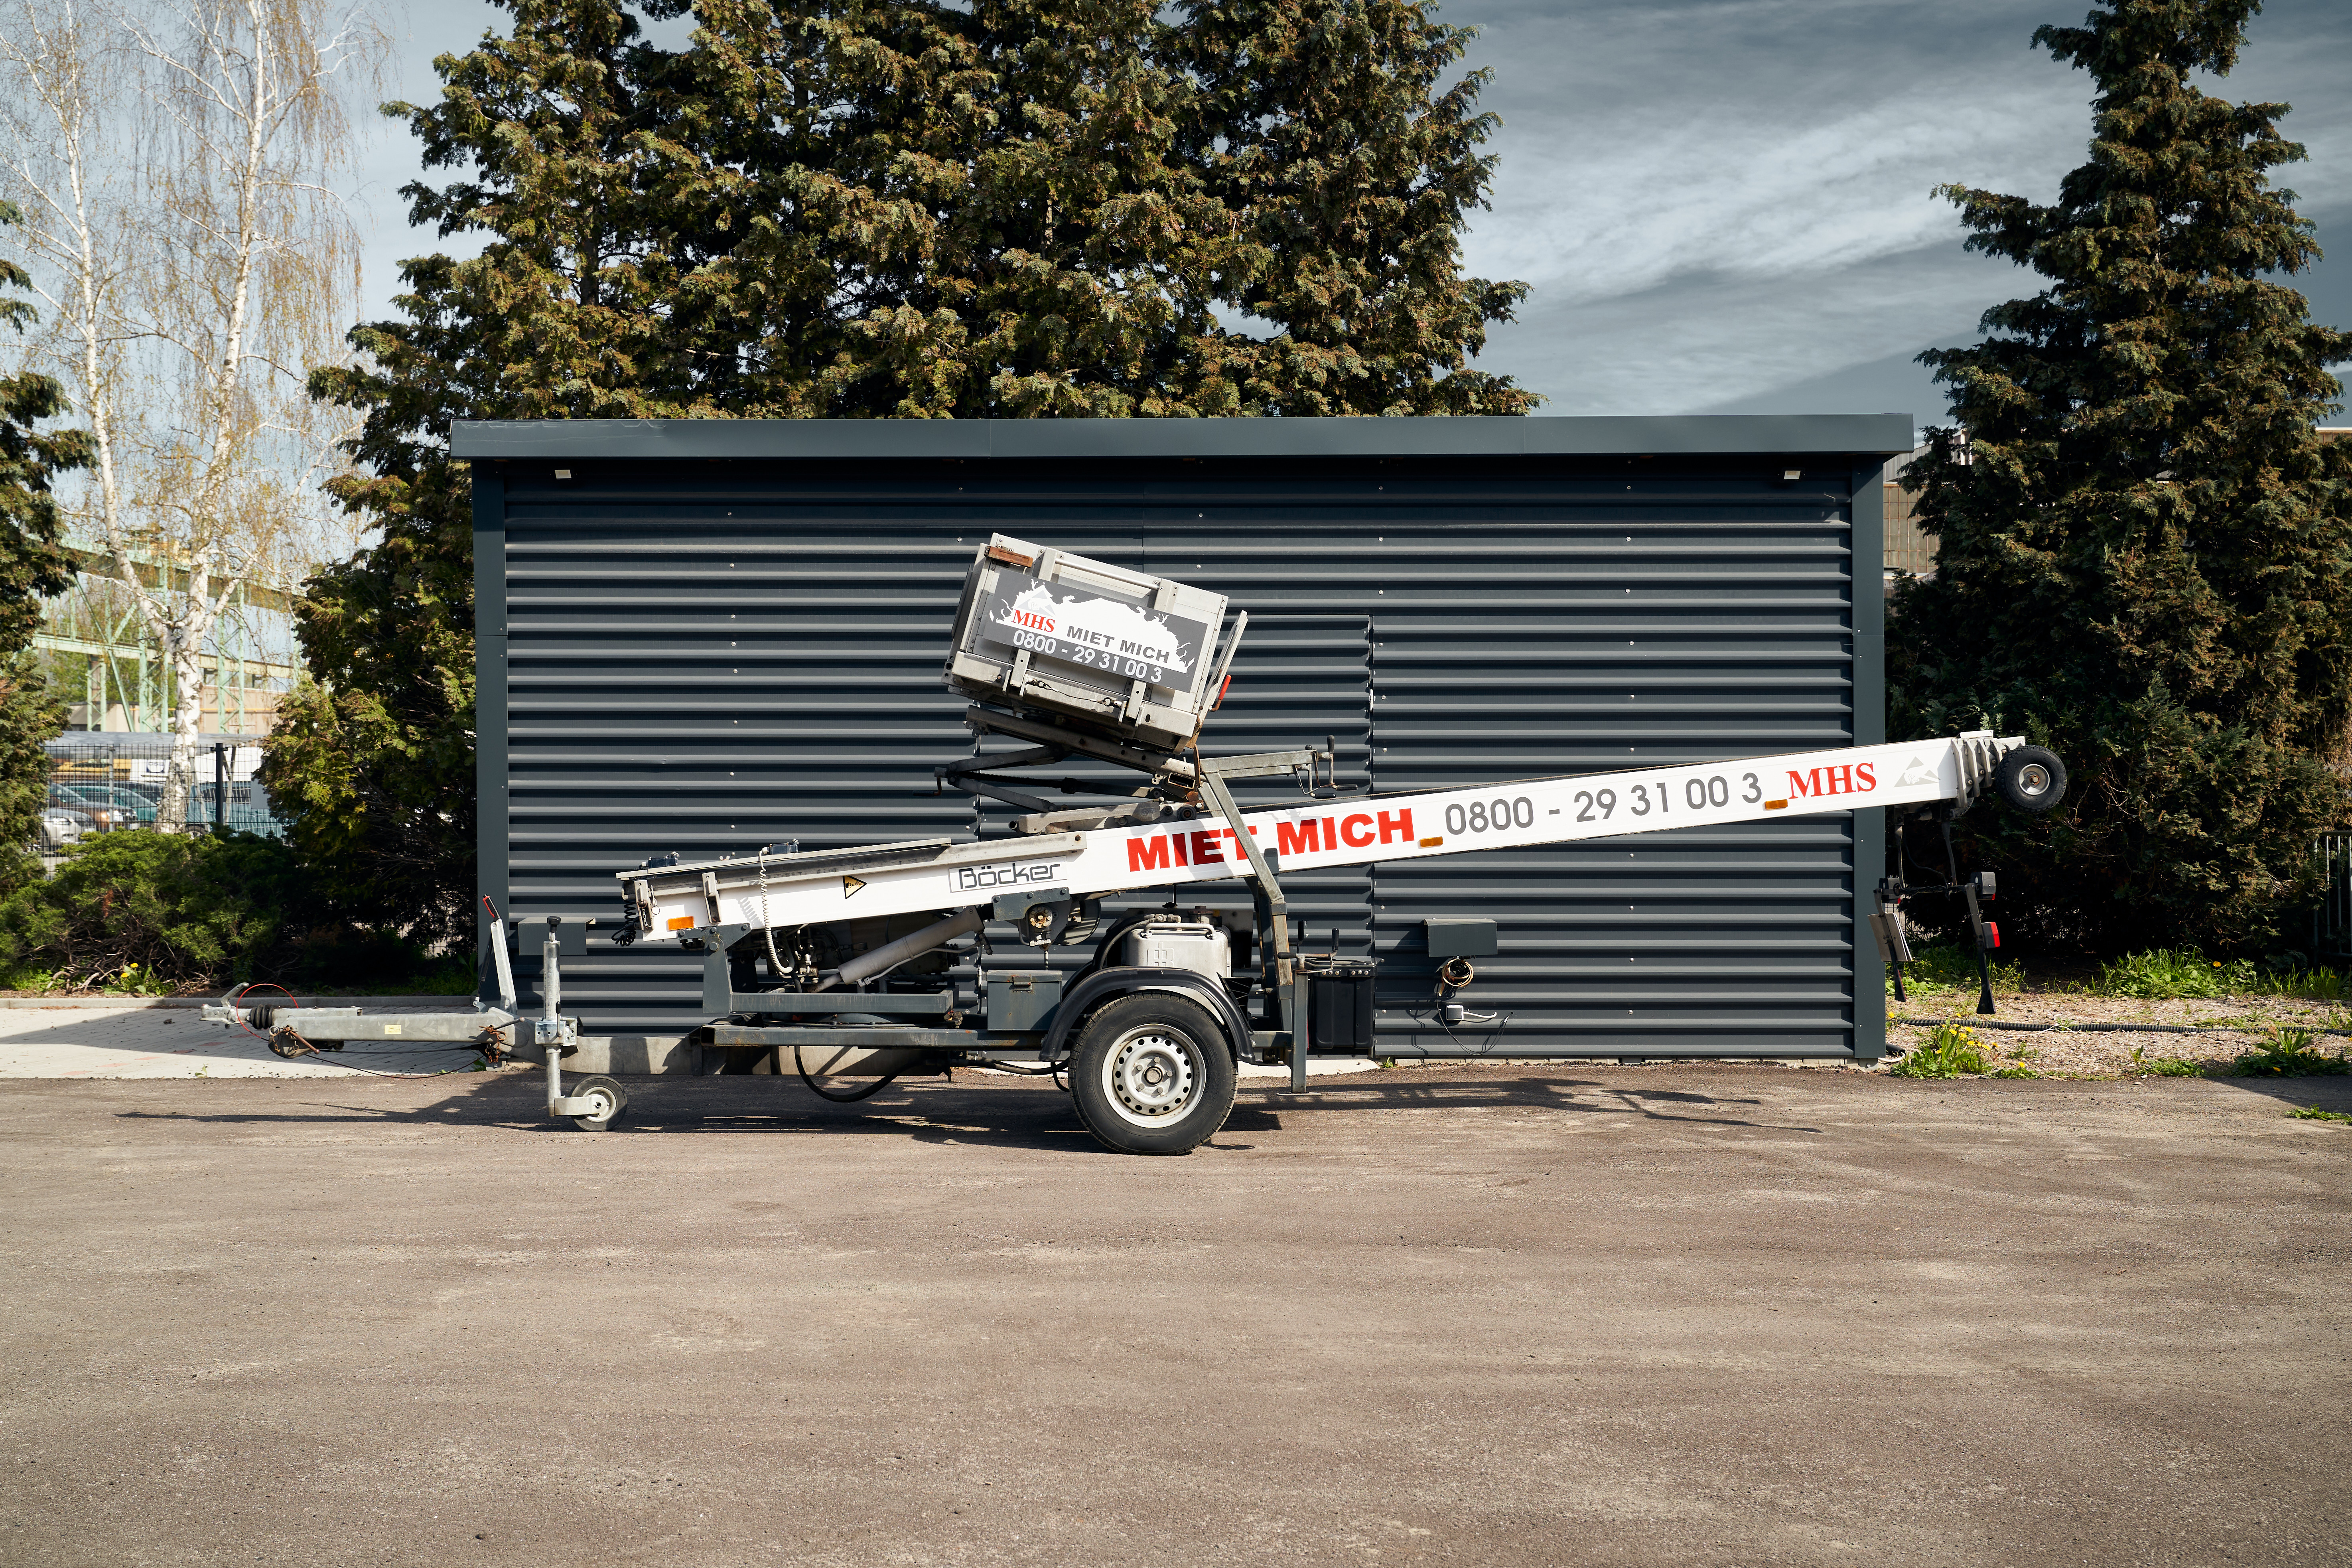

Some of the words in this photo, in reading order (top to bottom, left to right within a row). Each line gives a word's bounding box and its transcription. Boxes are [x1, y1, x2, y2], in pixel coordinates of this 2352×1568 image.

[1011, 609, 1056, 633] MHS
[1013, 630, 1057, 655] 0800
[1072, 646, 1096, 665] 29
[1098, 653, 1120, 672] 31
[1125, 660, 1147, 679] 00
[1151, 667, 1162, 683] 3
[1067, 625, 1115, 648] MIET
[1120, 640, 1169, 664] MICH
[1445, 797, 1534, 835] 0800
[1574, 788, 1617, 822] 29
[1630, 782, 1668, 816] 31
[1686, 776, 1729, 810] 00
[1742, 772, 1762, 803] 3
[1786, 762, 1877, 799] MHS
[1127, 825, 1257, 872] MIET
[1276, 808, 1415, 856] MICH
[958, 863, 1061, 889] Böcker
[1085, 1024, 1115, 1094] HANKOOK
